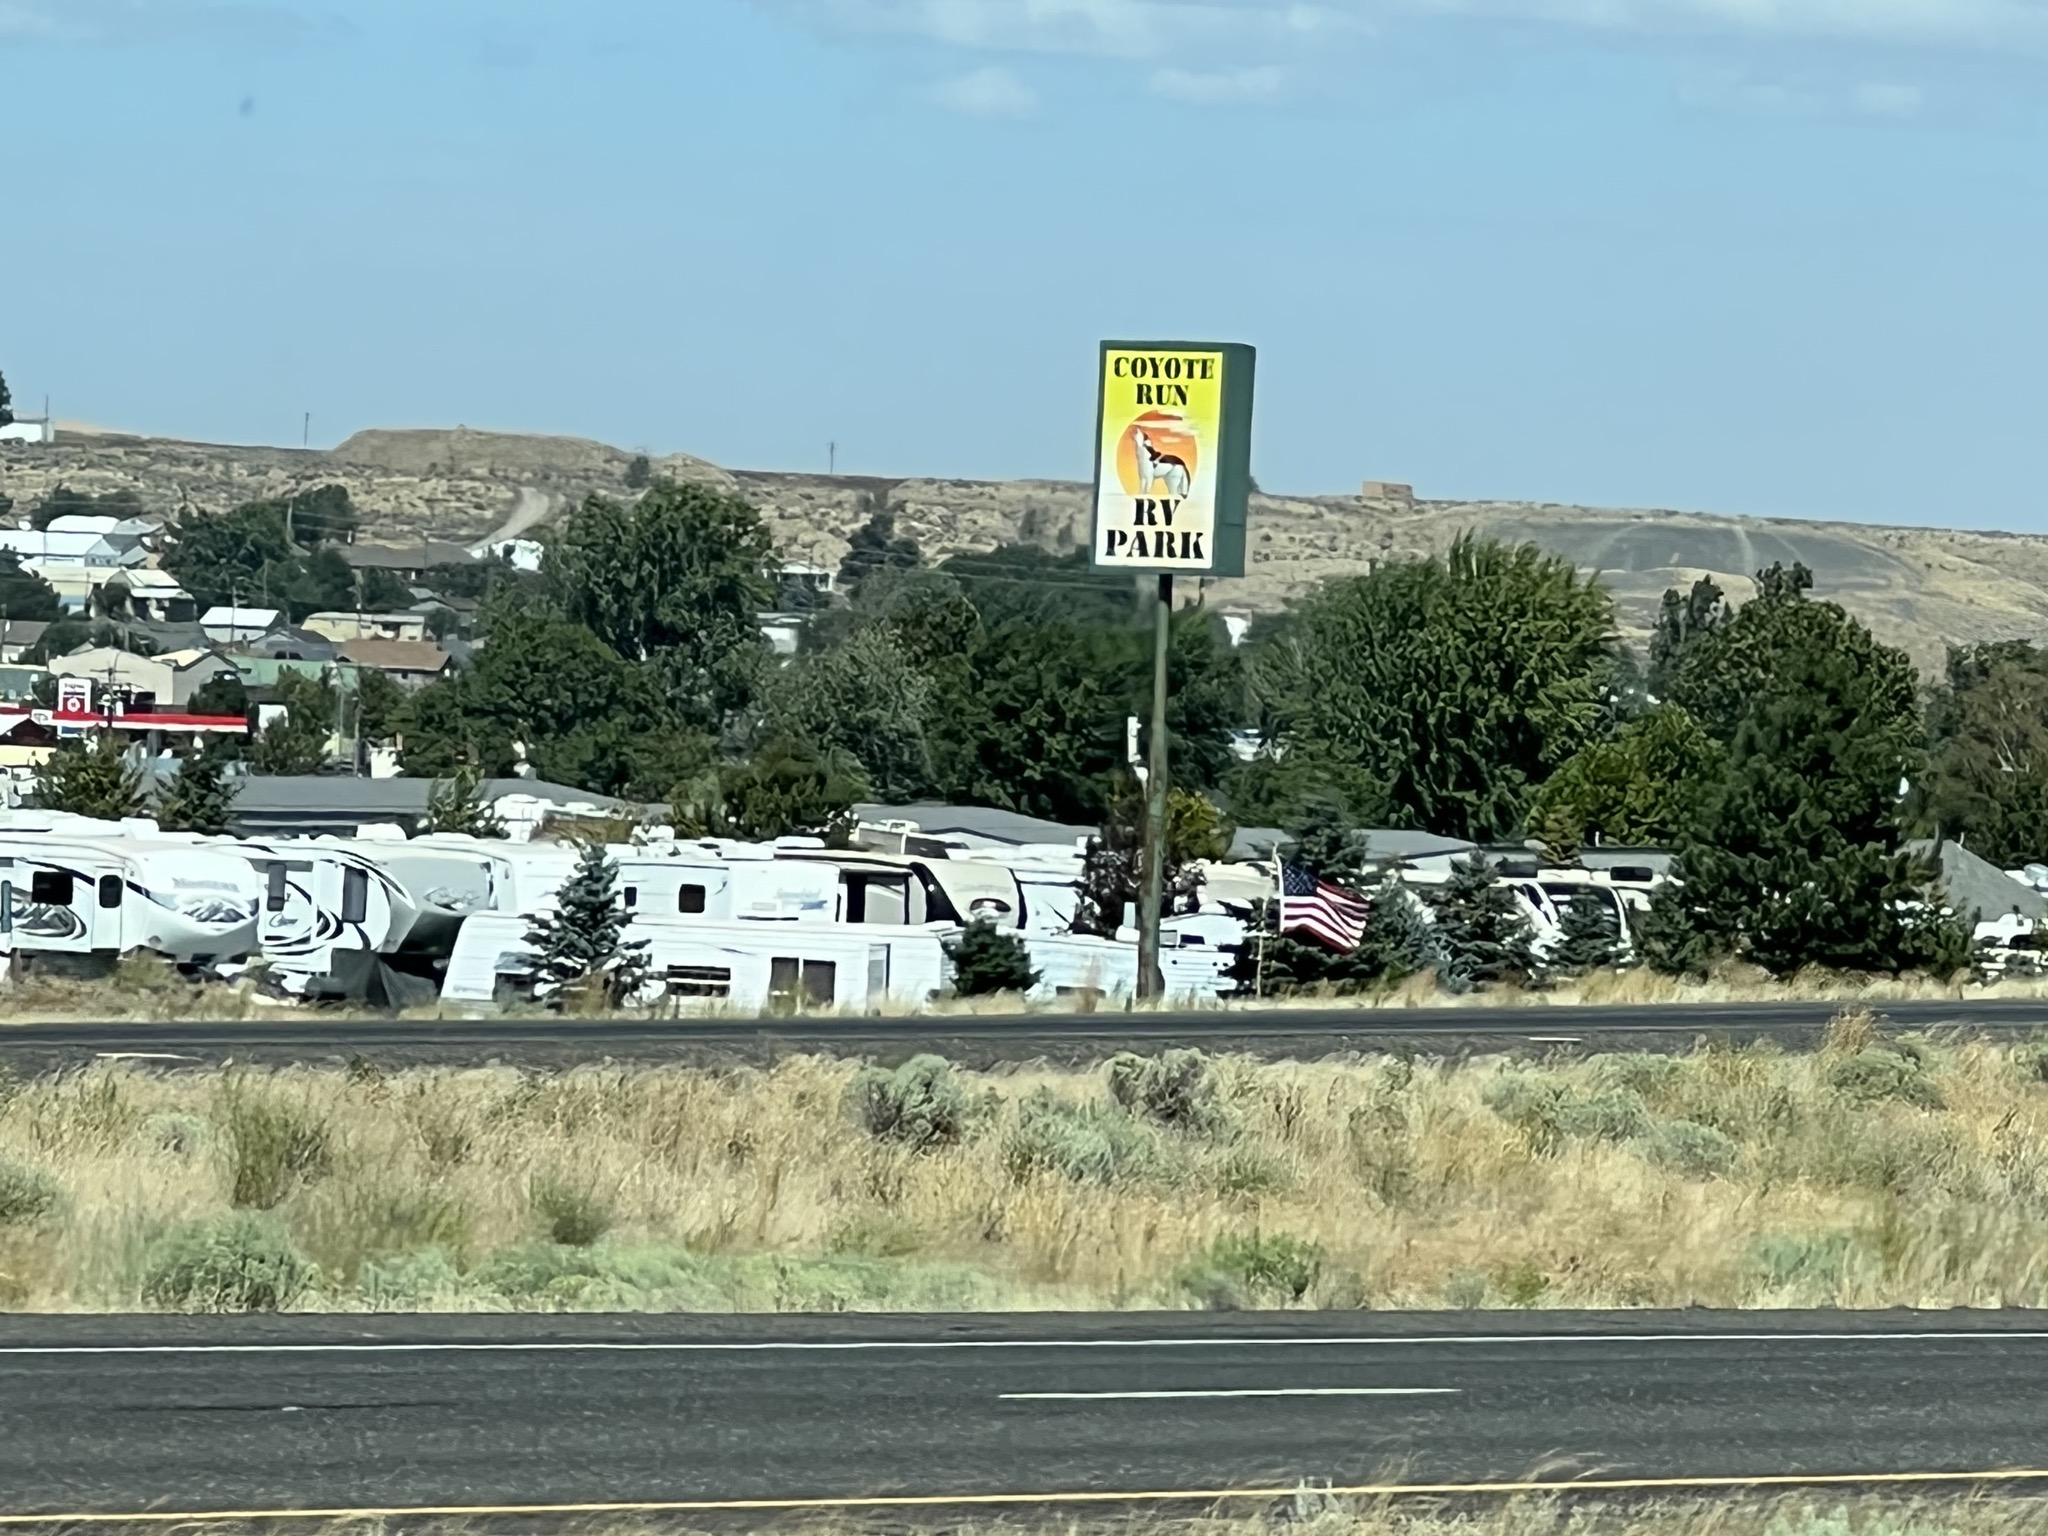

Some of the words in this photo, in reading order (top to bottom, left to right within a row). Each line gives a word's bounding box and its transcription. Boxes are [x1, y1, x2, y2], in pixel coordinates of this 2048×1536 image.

[1114, 357, 1215, 379] COYOTE
[1136, 383, 1189, 406] RUN
[1133, 498, 1181, 526] RV
[1105, 529, 1205, 560] PARK
